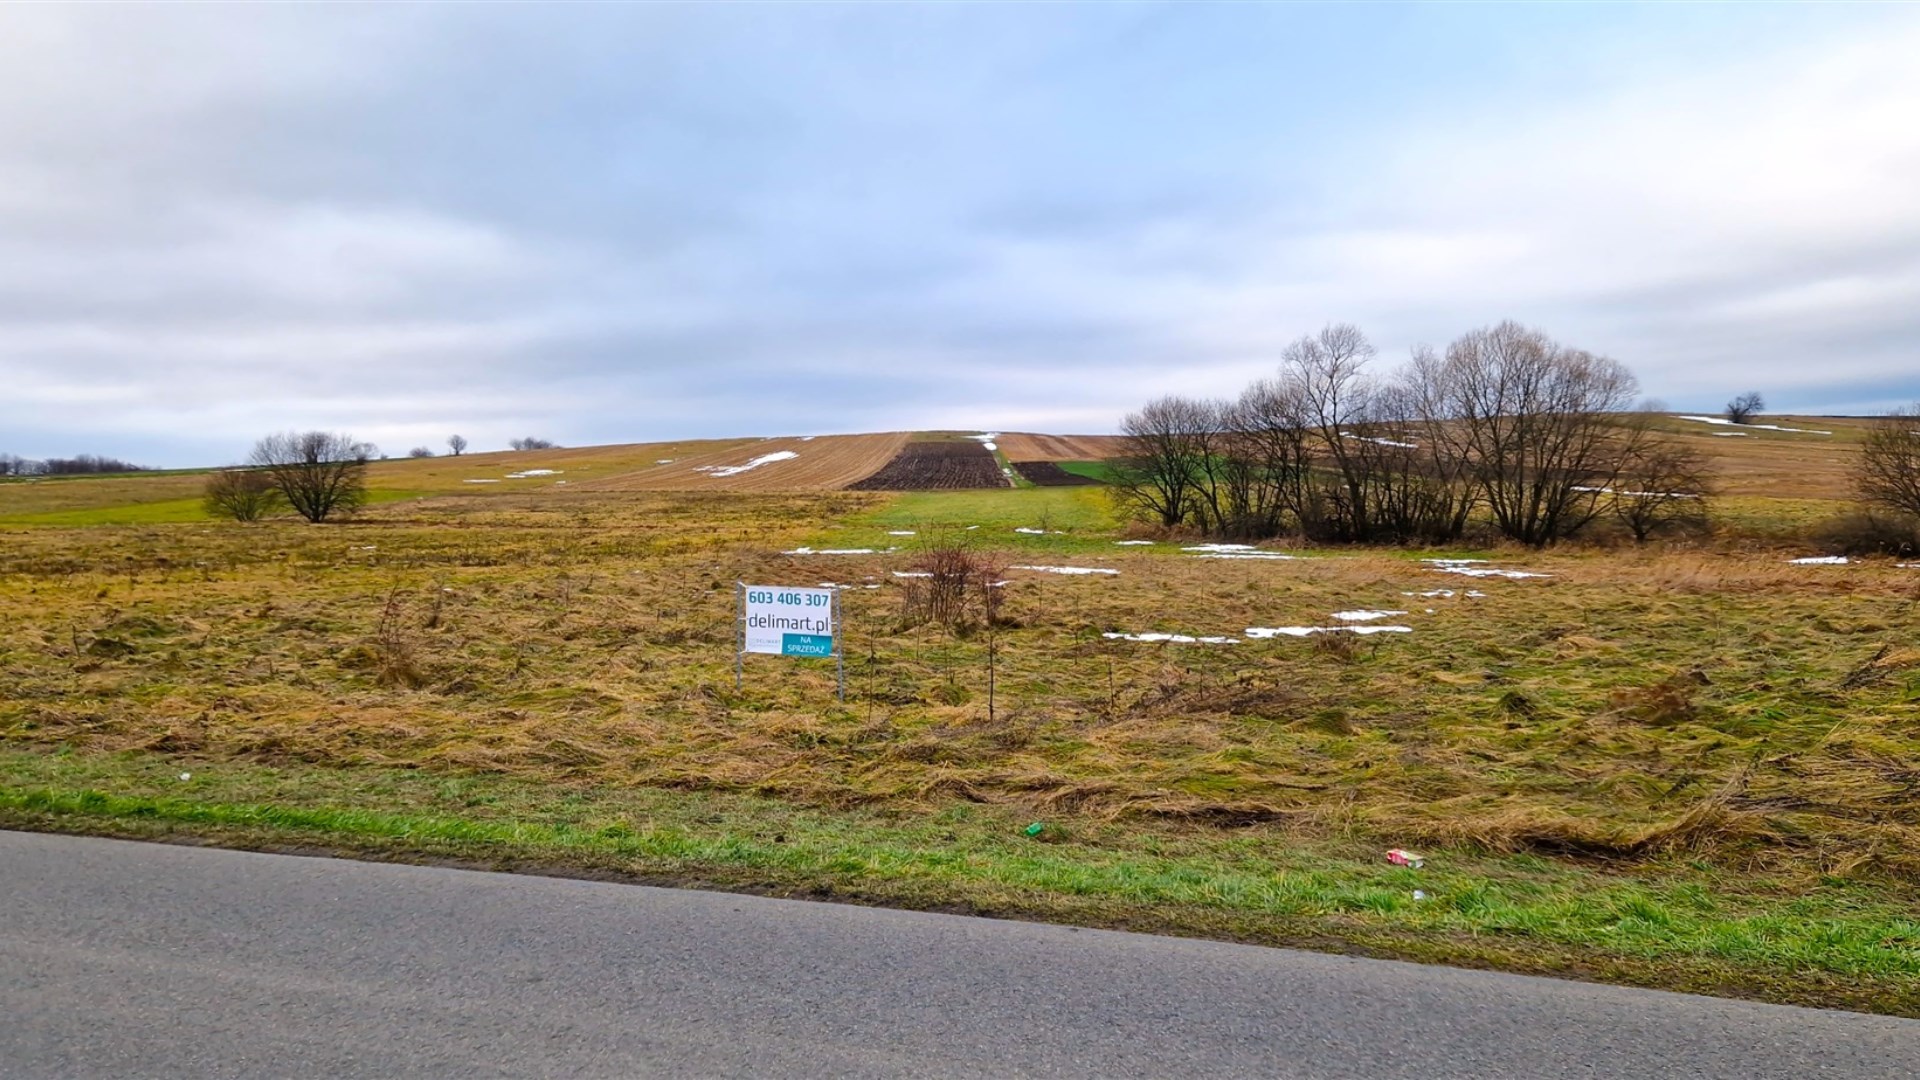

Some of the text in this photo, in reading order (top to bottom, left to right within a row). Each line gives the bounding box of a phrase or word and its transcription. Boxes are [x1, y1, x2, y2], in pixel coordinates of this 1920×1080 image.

[749, 591, 828, 606] 603 406 307
[749, 613, 828, 634] delimart.pl
[800, 636, 812, 644] NA
